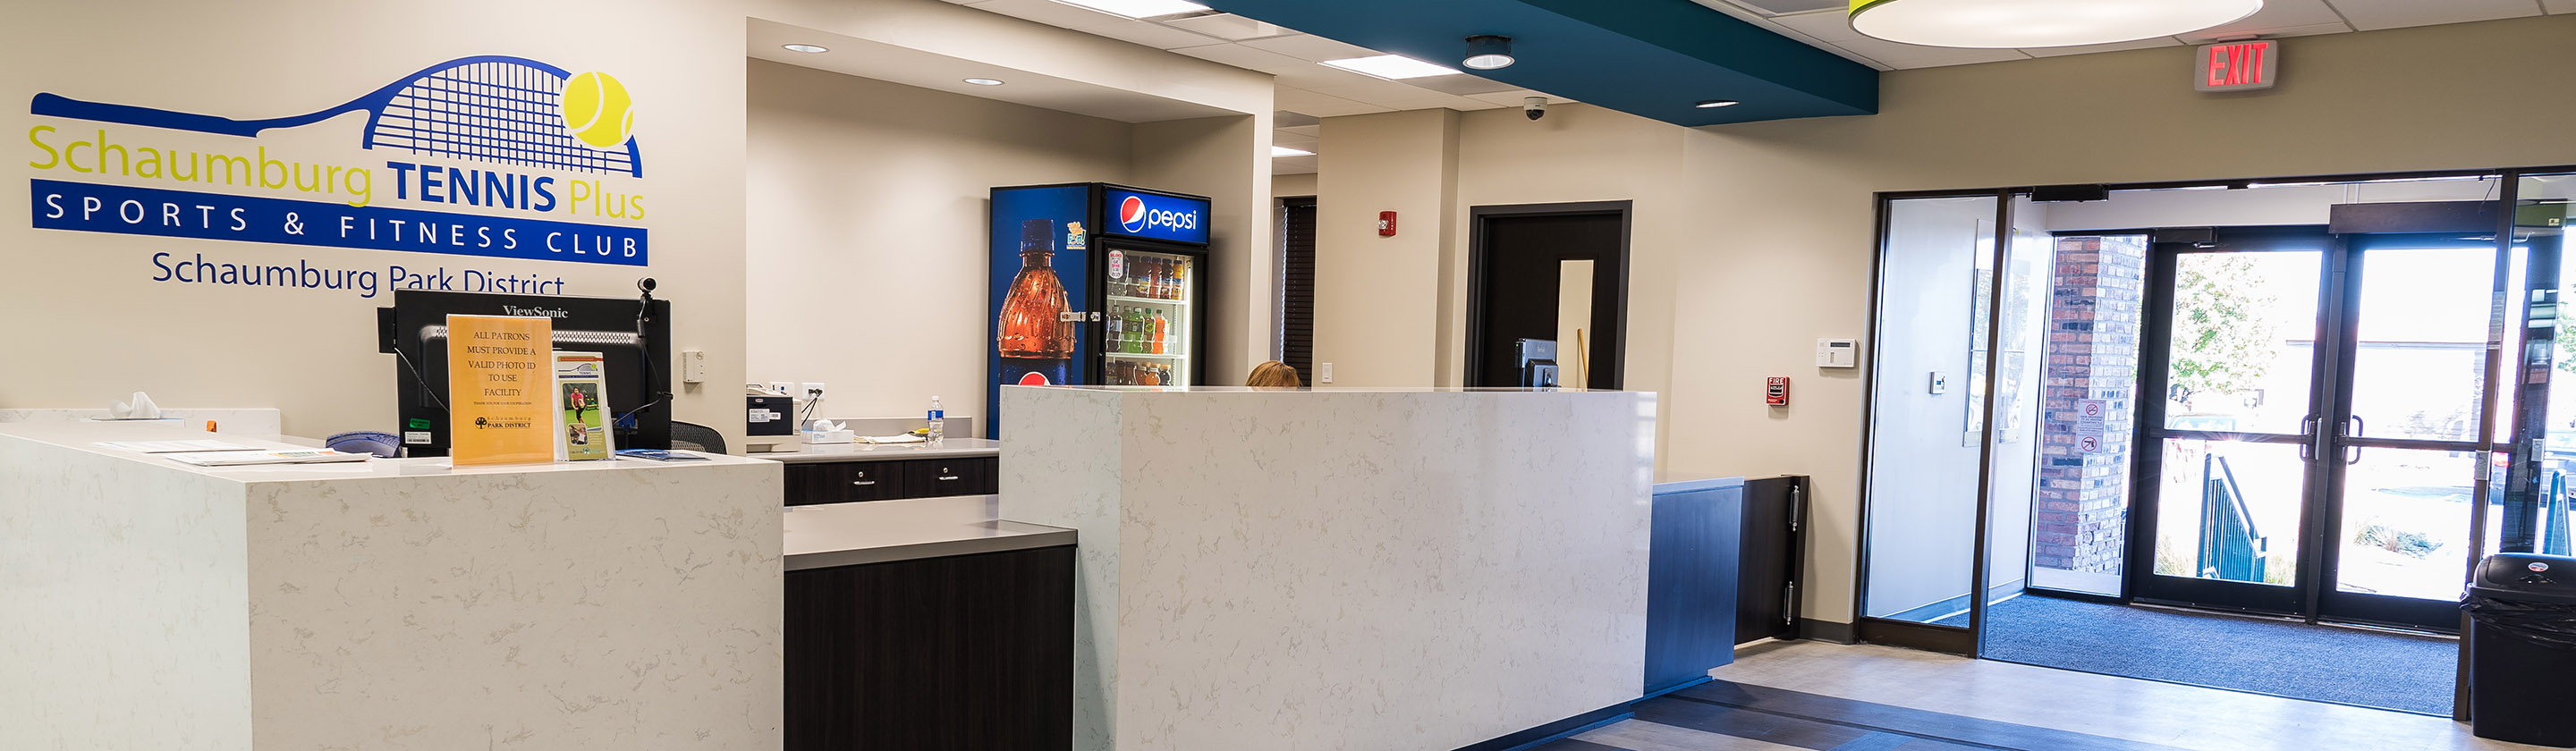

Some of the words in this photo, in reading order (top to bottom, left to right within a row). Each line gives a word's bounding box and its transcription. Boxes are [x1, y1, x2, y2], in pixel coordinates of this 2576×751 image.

[2207, 43, 2268, 86] EXIT
[29, 125, 372, 207] Schaumburg
[386, 161, 557, 214] TENNIS
[570, 179, 646, 221] Plus
[45, 192, 248, 232] SPORTS
[283, 211, 305, 236] &
[340, 215, 518, 250] FITNESS
[546, 232, 639, 259] CLUB
[1148, 208, 1197, 232] pepsi
[153, 253, 377, 299] Schaumburg
[390, 266, 453, 291] Park
[463, 270, 565, 295] District
[503, 305, 569, 319] ViewSonic
[473, 332, 489, 340] ALL
[491, 332, 530, 341] PATRONS
[467, 346, 491, 354] MUST
[492, 347, 529, 355] PROVIDE
[530, 348, 537, 356] A
[468, 361, 495, 369] VALID
[496, 361, 526, 369] PHOTO
[527, 362, 537, 370] ID
[488, 374, 500, 382] TO
[501, 374, 517, 382] USE
[484, 388, 521, 397] FACILITY
